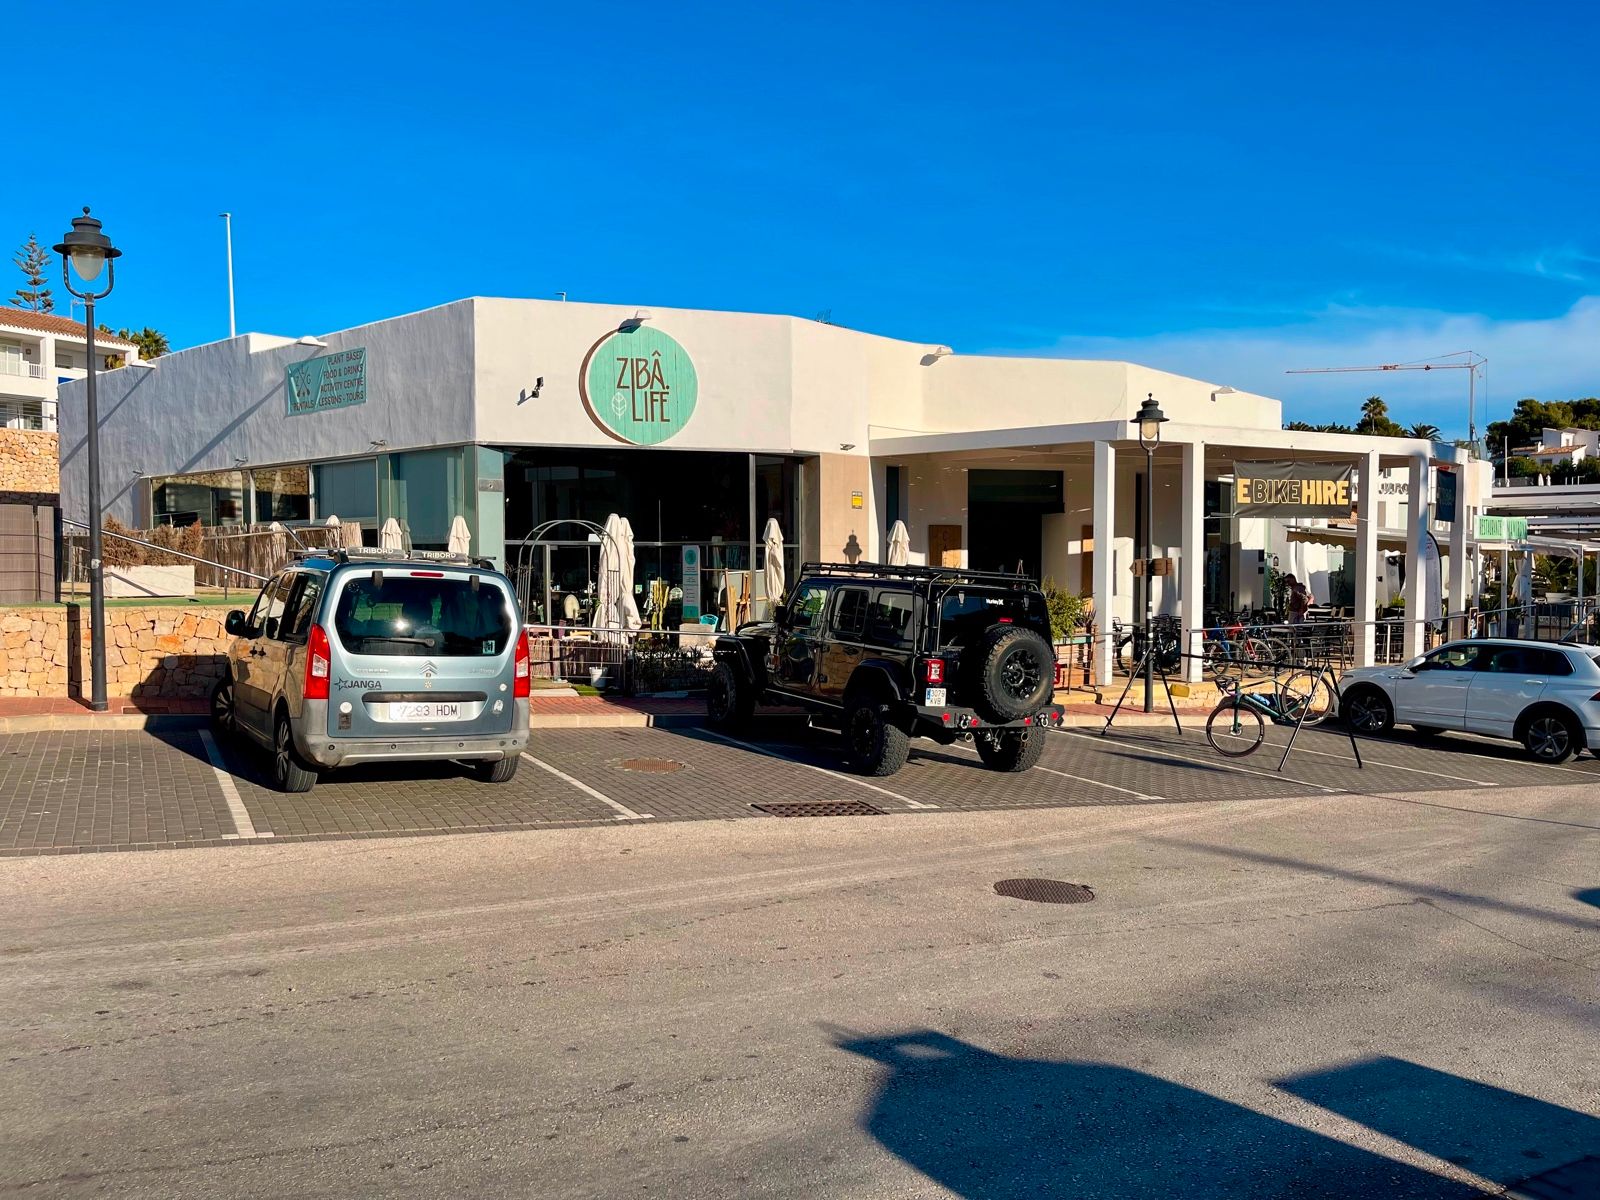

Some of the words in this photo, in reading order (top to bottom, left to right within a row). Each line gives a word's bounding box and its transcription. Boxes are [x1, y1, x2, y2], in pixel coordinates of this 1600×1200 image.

[327, 354, 344, 365] PLANT
[346, 351, 363, 361] BASED
[323, 368, 337, 379] FOOD
[344, 364, 363, 376] DRINKS
[320, 381, 343, 393] ACTIVITY
[344, 377, 364, 389] CENTRE
[319, 394, 342, 407] LESSONS
[346, 391, 364, 403] TOURS
[632, 391, 670, 422] LIFE
[1237, 478, 1251, 504] E
[1253, 479, 1300, 504] BIKE
[1301, 479, 1349, 505] HIRE
[358, 547, 394, 555] TRIBORD
[421, 551, 456, 559] TRIBORD
[347, 680, 382, 689] JANGA
[436, 704, 458, 716] HDM
